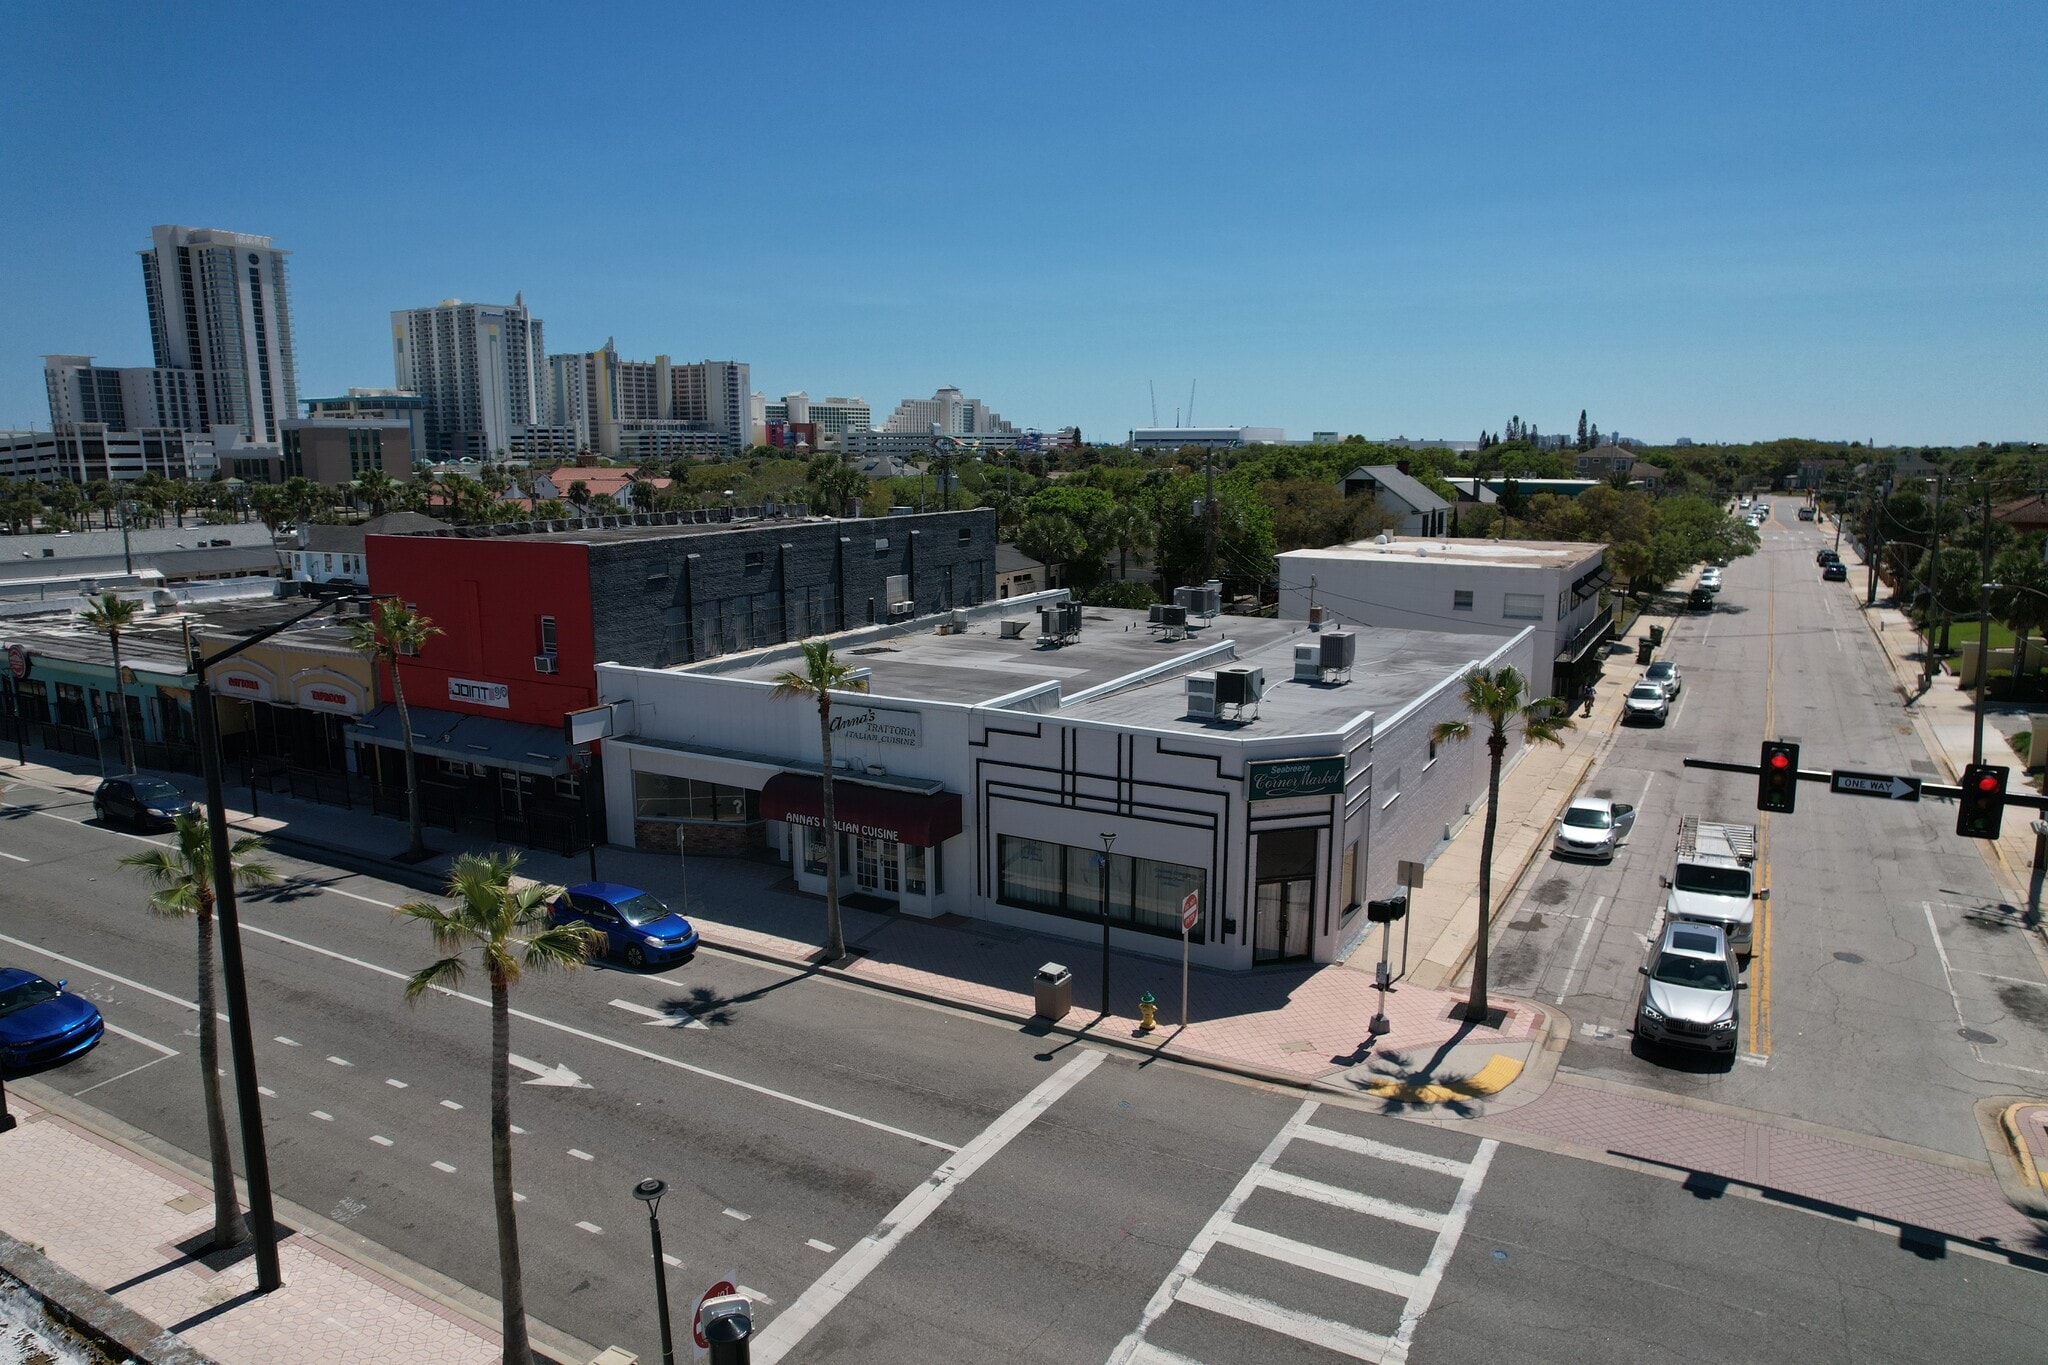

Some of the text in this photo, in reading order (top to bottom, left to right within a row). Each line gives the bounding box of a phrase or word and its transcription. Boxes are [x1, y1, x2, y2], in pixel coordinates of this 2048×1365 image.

[829, 709, 875, 733] Anna's
[845, 731, 915, 746] ITALIAN CUISINE
[1271, 764, 1311, 774] Seabreeze
[1254, 773, 1298, 789] Corner
[1845, 778, 1892, 791] ONE WAY
[786, 812, 899, 841] ANNA'S IALIAN CUISINE
